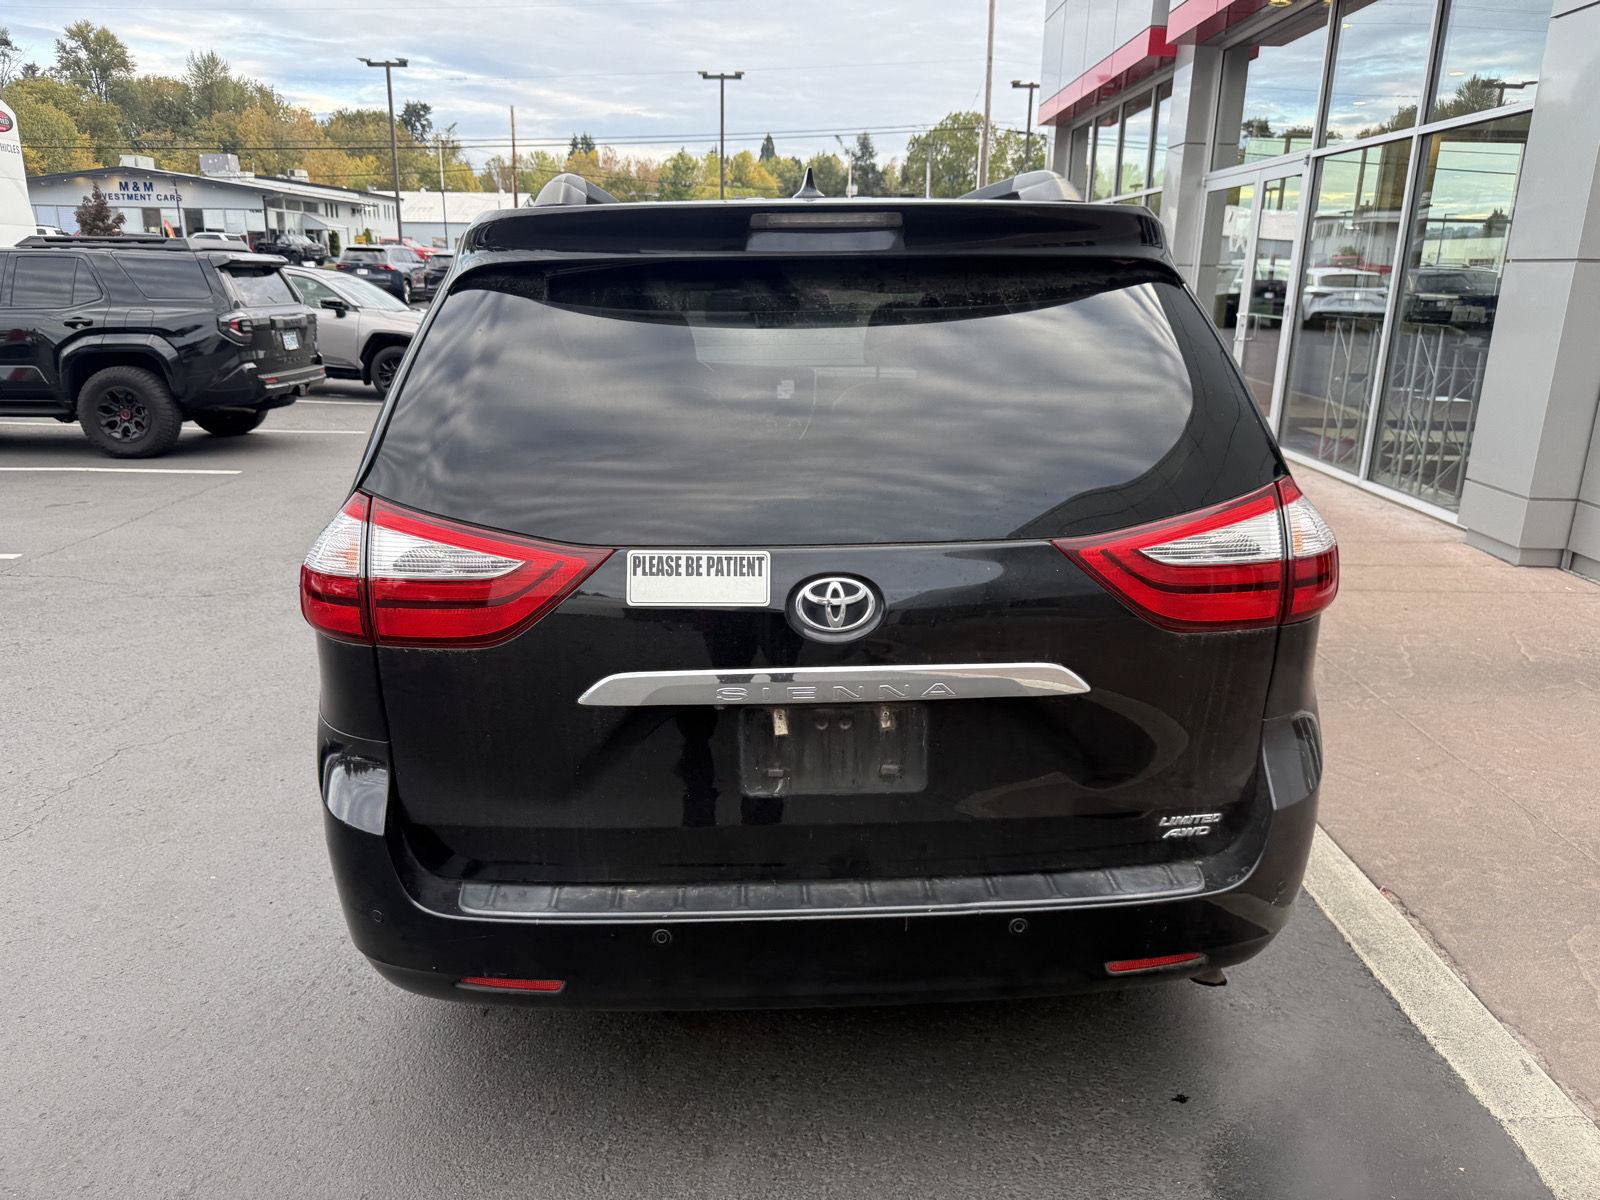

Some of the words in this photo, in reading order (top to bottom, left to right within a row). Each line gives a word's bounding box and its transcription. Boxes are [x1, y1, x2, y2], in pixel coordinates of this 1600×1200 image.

[0, 143, 20, 154] HICLES
[118, 181, 129, 191] M
[132, 181, 140, 191] &
[143, 182, 154, 192] M
[97, 193, 152, 201] VESTMENT
[156, 194, 183, 202] CARS
[632, 555, 682, 577] PLEASE
[685, 556, 703, 577] BE
[706, 556, 765, 577] PATIENT
[715, 682, 957, 701] SIENNA
[1159, 813, 1222, 827] LIMITED
[1162, 826, 1211, 839] AWD
